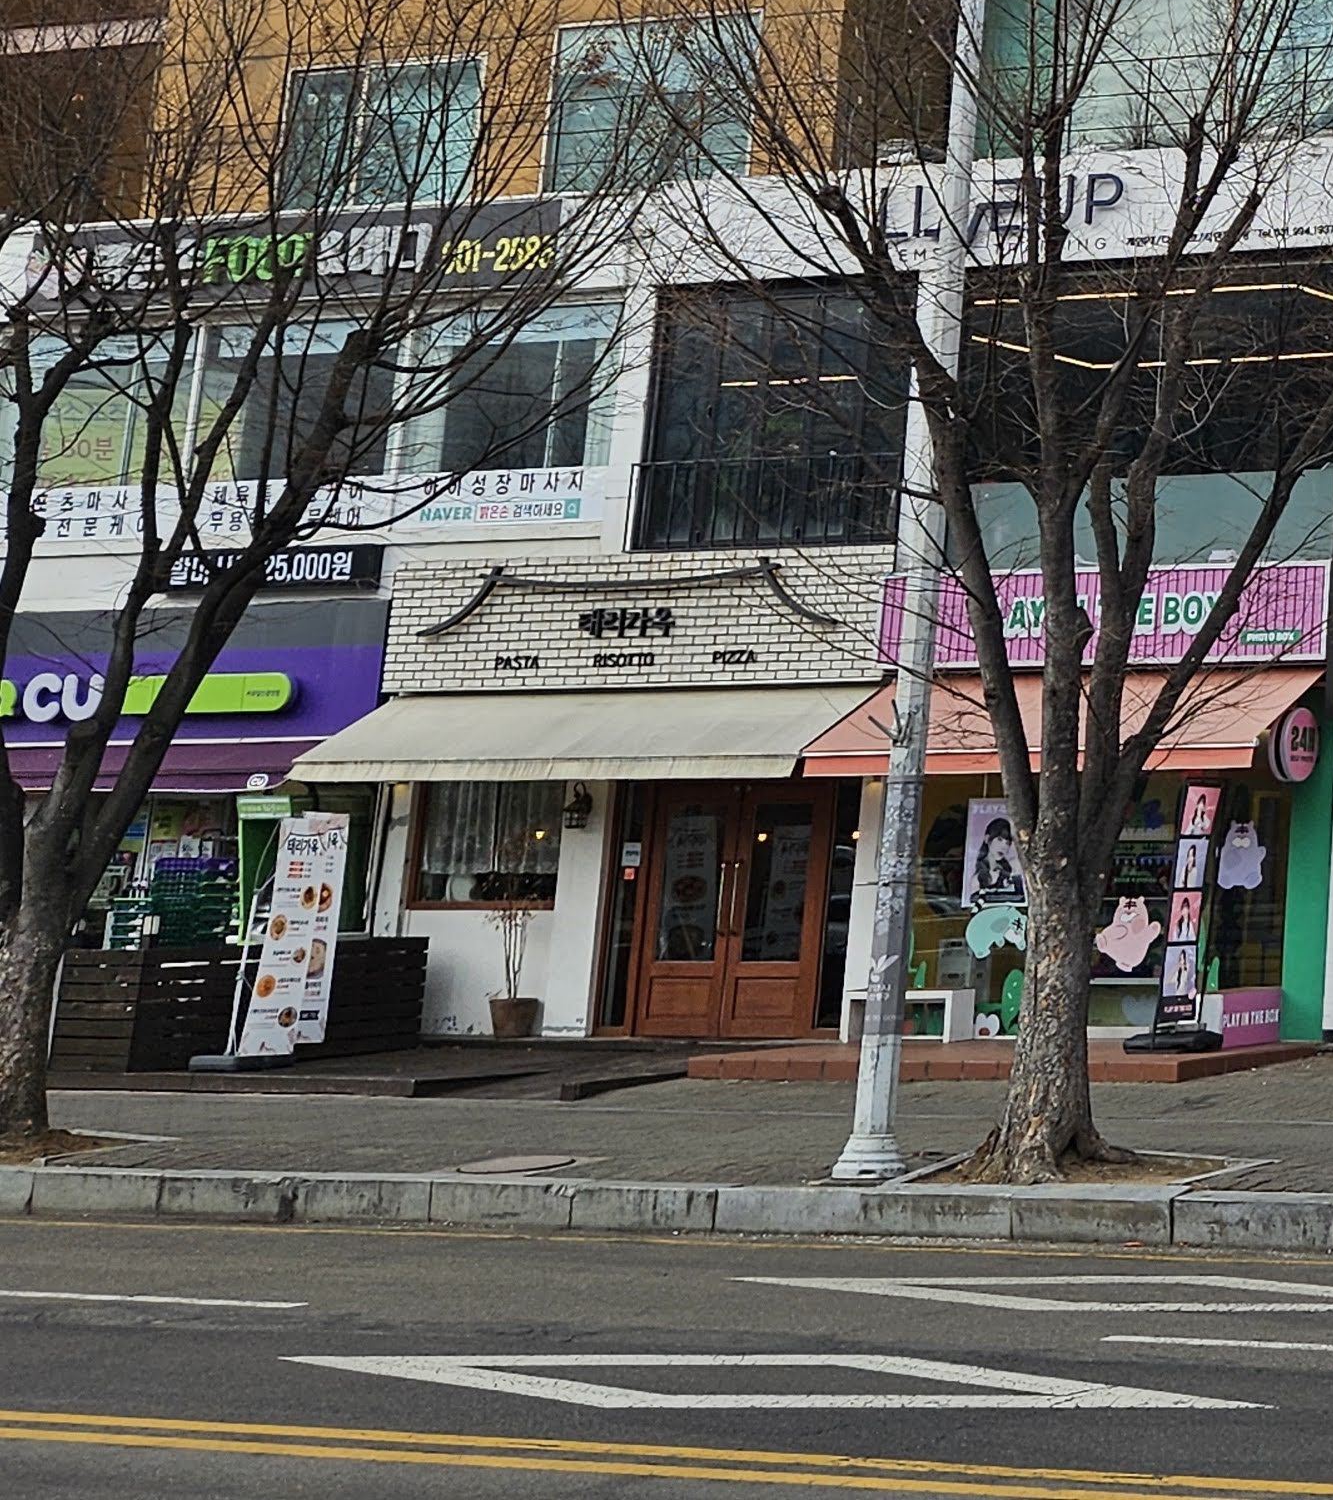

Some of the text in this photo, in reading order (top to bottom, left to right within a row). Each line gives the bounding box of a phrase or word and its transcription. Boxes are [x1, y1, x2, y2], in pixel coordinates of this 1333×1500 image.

[420, 506, 472, 521] NAVER
[513, 503, 563, 517] 검색하세요
[1276, 632, 1295, 642] BOX
[495, 650, 755, 670] PASTA RISOTTO PIZZA
[23, 673, 105, 722] CU
